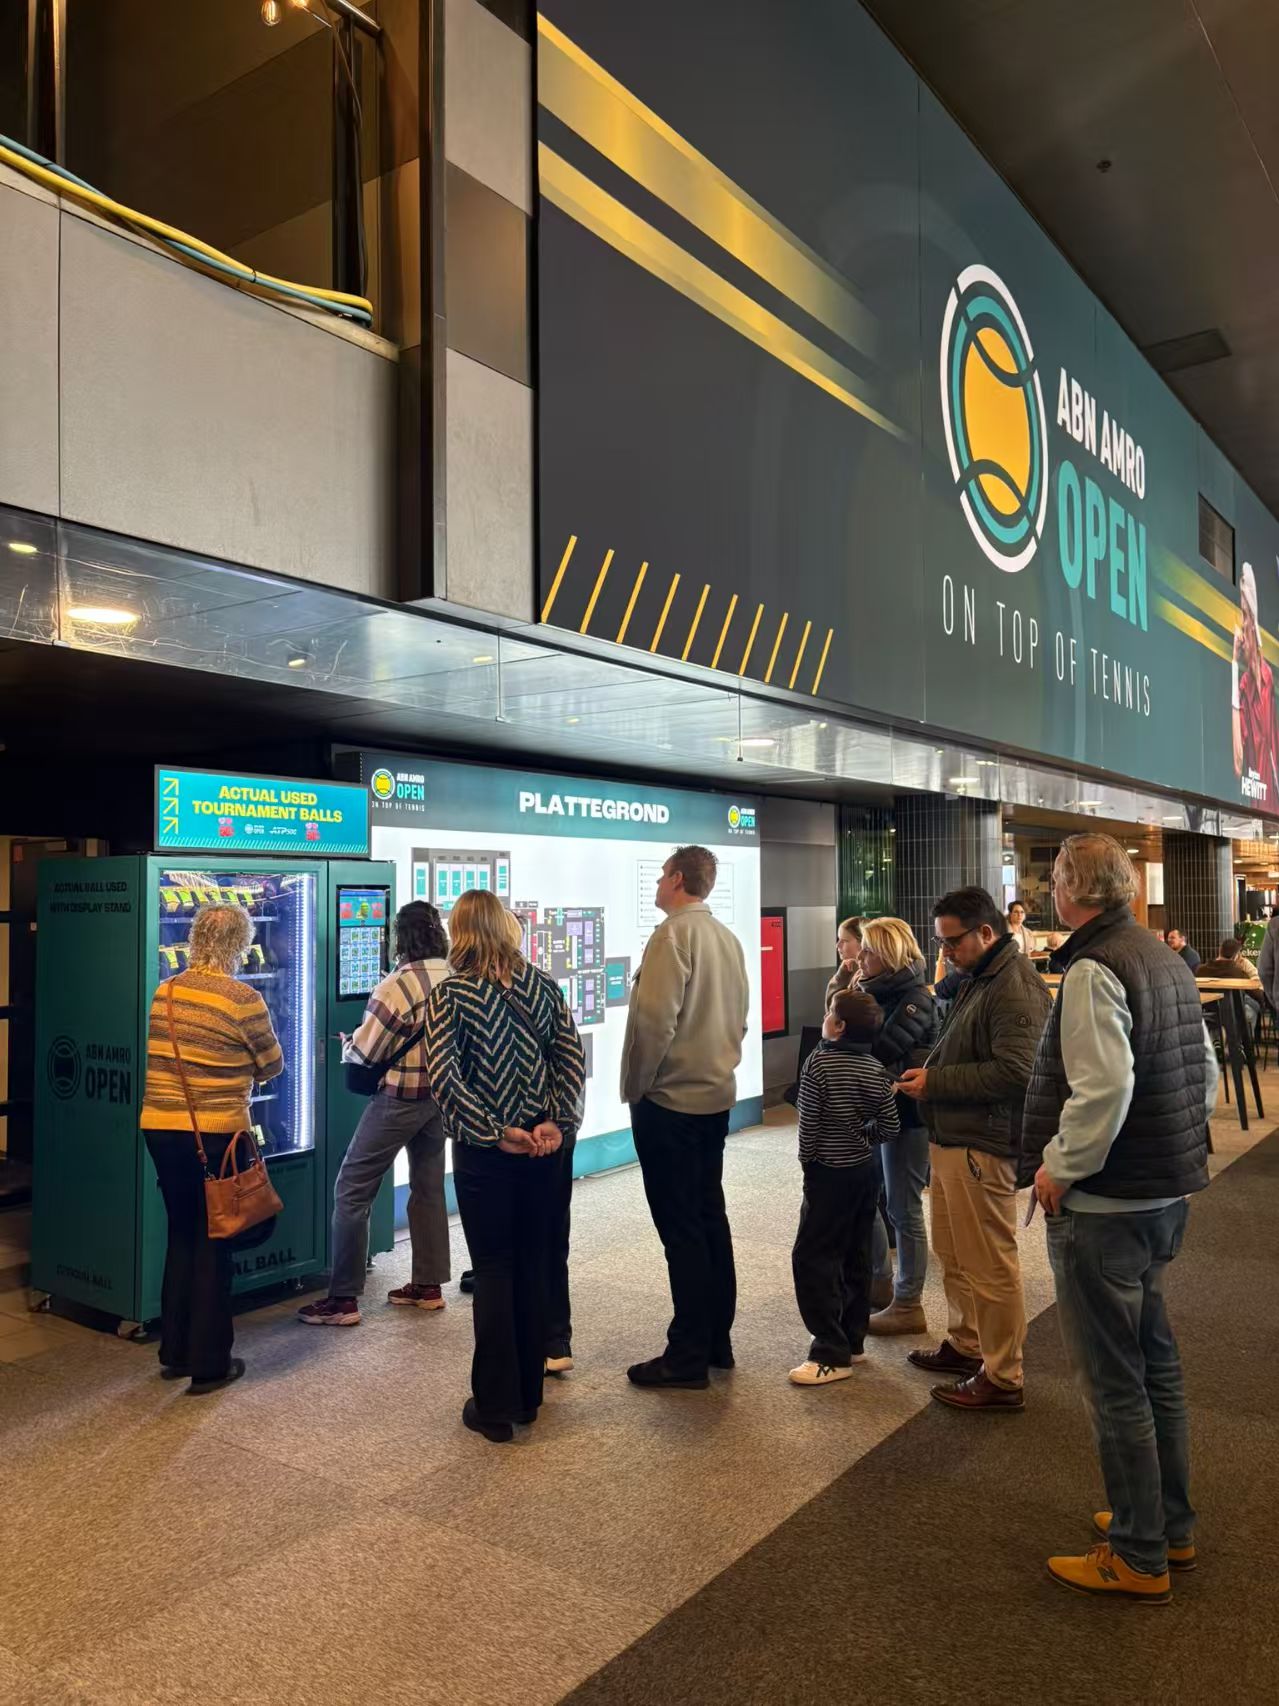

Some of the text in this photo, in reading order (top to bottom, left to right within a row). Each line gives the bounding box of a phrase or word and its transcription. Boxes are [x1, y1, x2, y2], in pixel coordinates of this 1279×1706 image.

[1057, 367, 1145, 500] ABN AMRO
[1058, 460, 1148, 632] OPEN
[943, 575, 1150, 716] ON TOP OF TENNIS
[219, 785, 318, 805] ACTUAL USED
[397, 782, 425, 801] OPEN
[1241, 775, 1267, 801] HEWITT
[192, 800, 343, 823] TOURNAMENT BALLS
[519, 791, 670, 824] PLATTEGROND
[105, 881, 128, 893] USED
[104, 901, 131, 913] STAND
[86, 1043, 132, 1065] ABN AMRO
[85, 1066, 132, 1105] OPEN
[255, 1248, 296, 1269] BALL
